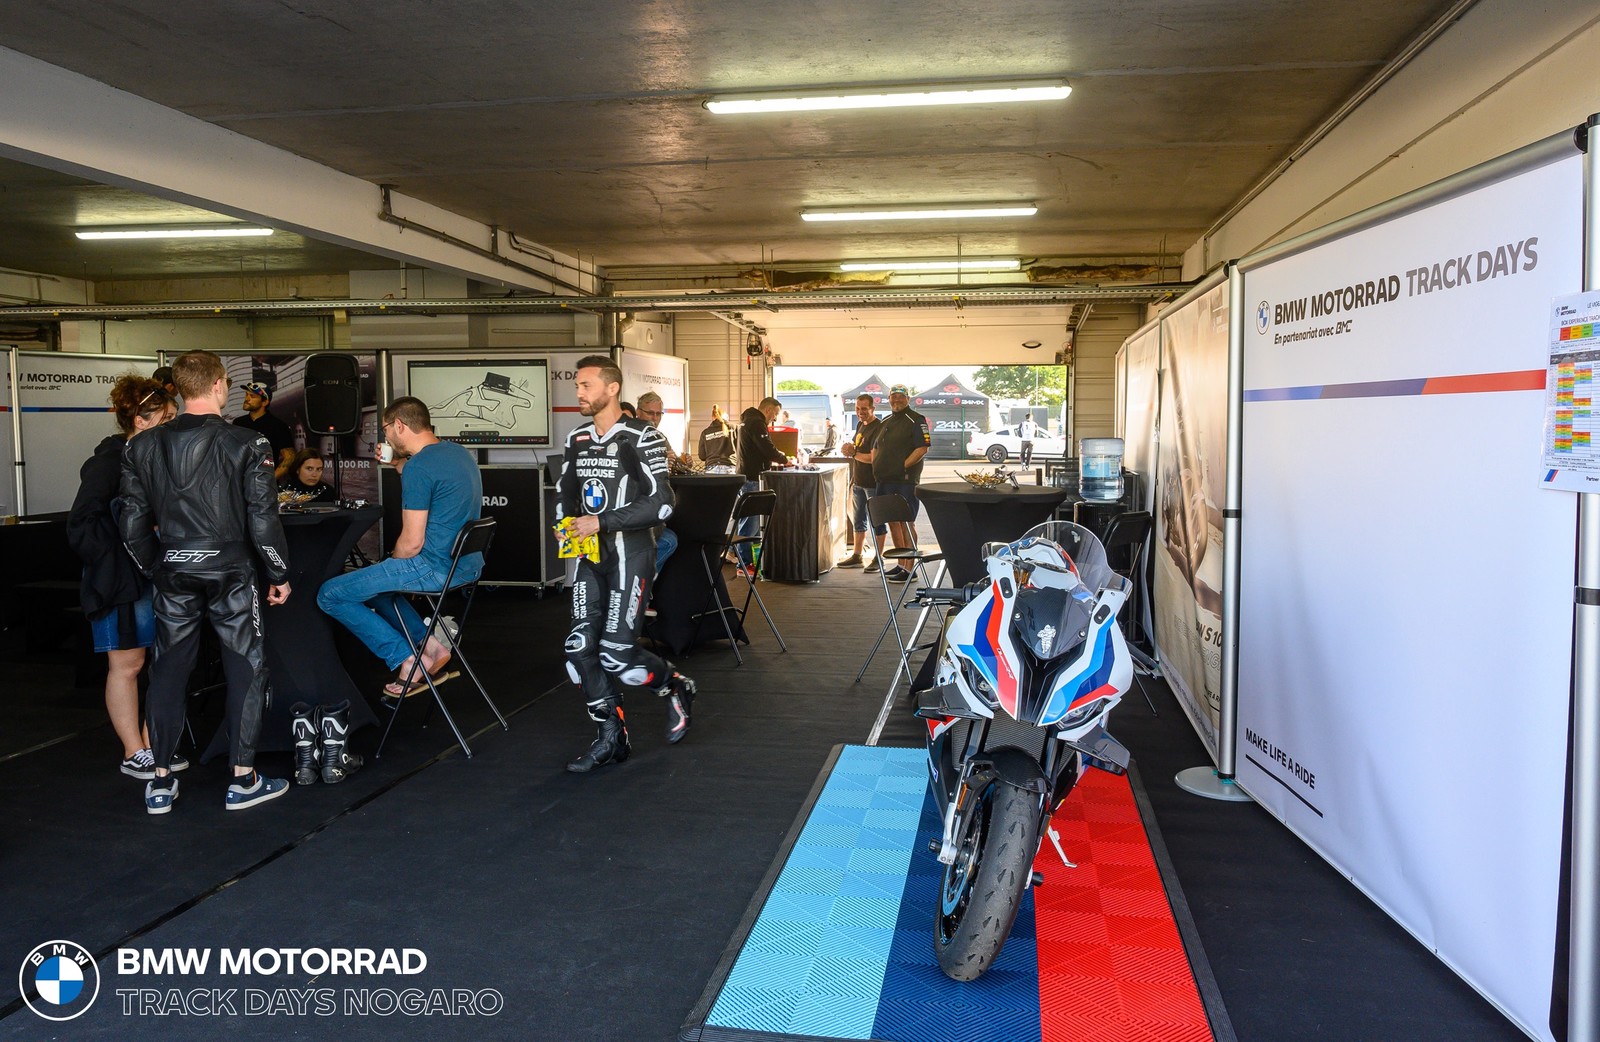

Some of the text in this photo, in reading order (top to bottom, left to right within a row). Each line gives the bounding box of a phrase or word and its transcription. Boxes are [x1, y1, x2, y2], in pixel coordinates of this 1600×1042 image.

[1275, 237, 1538, 325] BMW MOTORRAD TRACK DAYS
[1274, 334, 1281, 344] En
[1282, 327, 1318, 346] partenariat
[1318, 326, 1334, 337] avec
[27, 373, 92, 383] MOTORRAD
[95, 375, 120, 384] TRAC
[936, 421, 978, 429] 24MX
[357, 460, 370, 468] RR
[576, 458, 619, 467] MOTO RIDE
[576, 468, 615, 478] TOULOUSE
[164, 550, 220, 563] RST
[262, 545, 287, 570] RST
[579, 581, 587, 605] MOTO
[1204, 627, 1213, 642] S
[1213, 630, 1222, 647] 10
[1245, 728, 1315, 790] MAKE LIFE A RIDE
